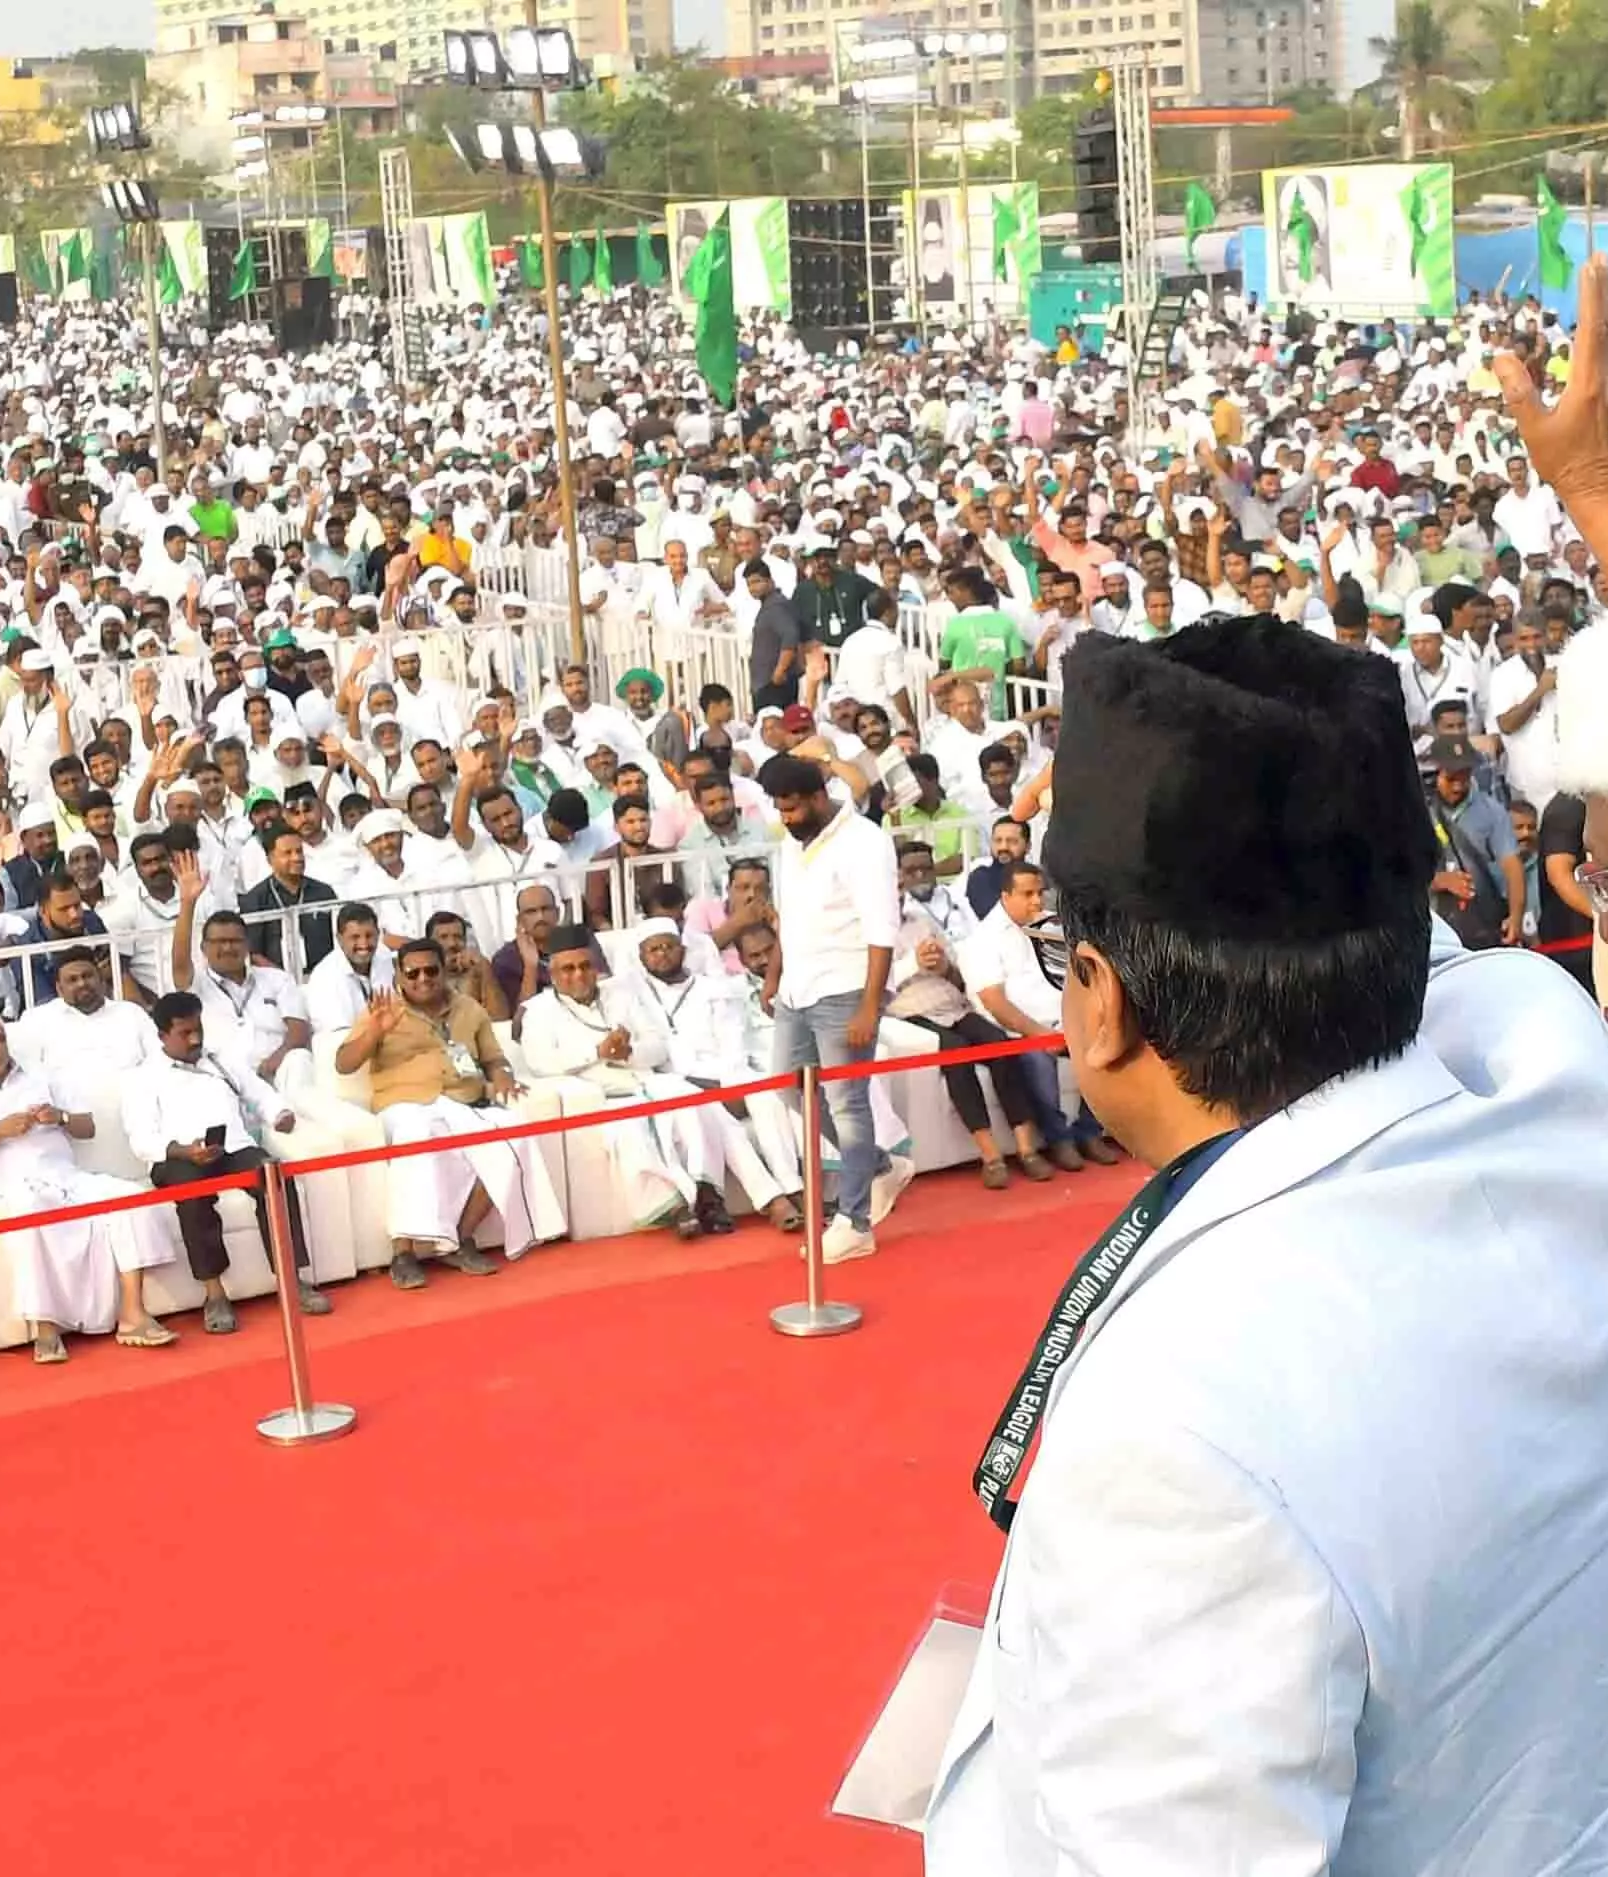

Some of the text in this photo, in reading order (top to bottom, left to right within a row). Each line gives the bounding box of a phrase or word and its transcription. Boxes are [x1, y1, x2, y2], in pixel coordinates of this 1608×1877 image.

[1088, 1221, 1143, 1283] INDIAN
[1058, 1275, 1102, 1324] UNION
[1029, 1322, 1074, 1383] MUSLIM
[1002, 1384, 1044, 1444] LEAGUE
